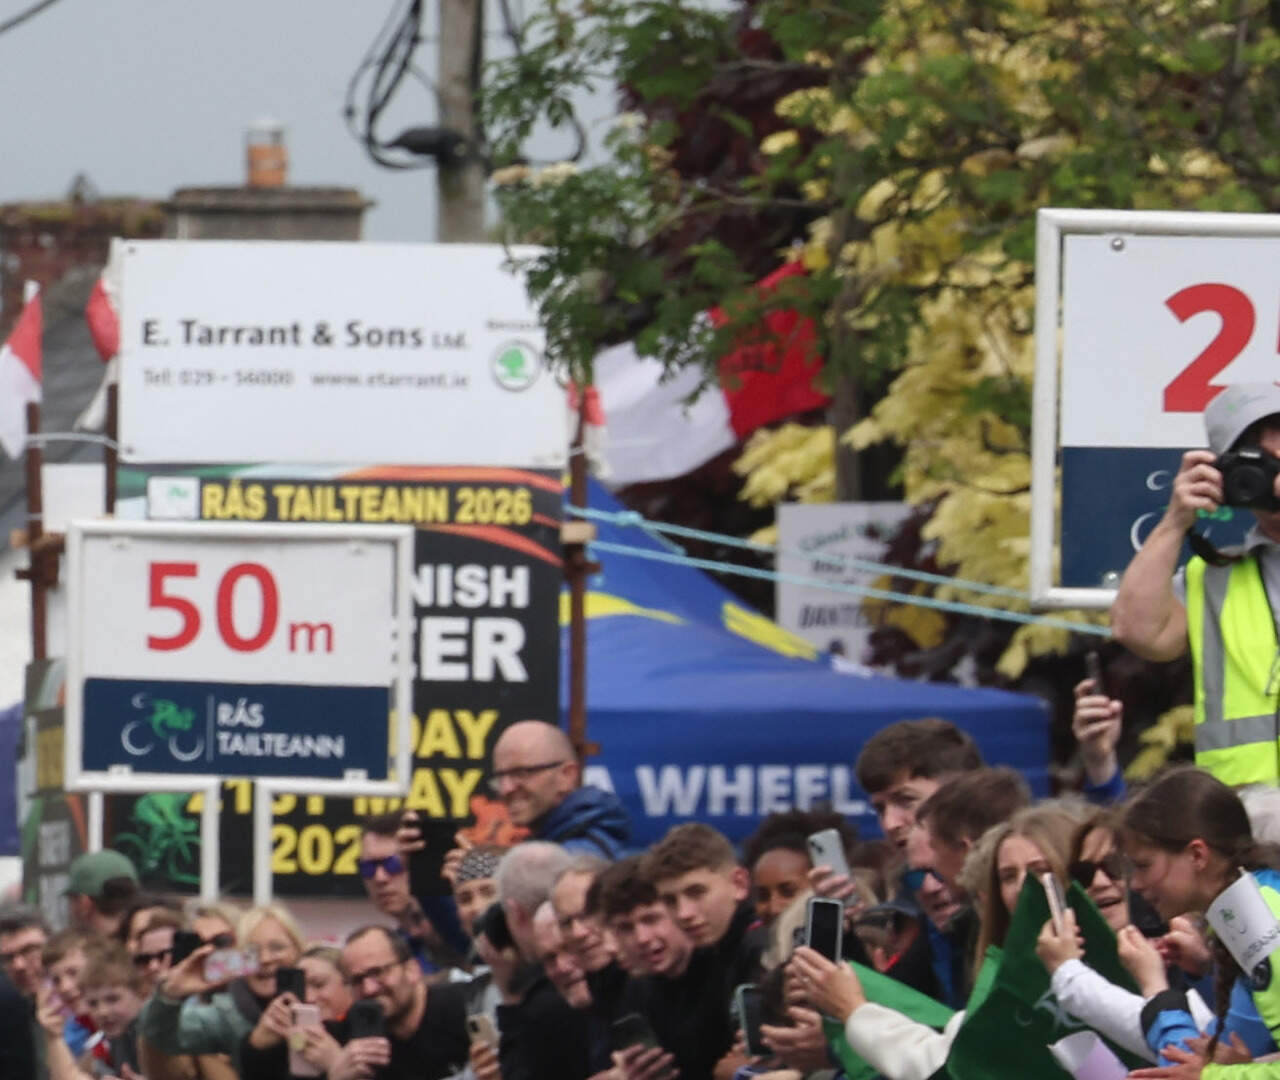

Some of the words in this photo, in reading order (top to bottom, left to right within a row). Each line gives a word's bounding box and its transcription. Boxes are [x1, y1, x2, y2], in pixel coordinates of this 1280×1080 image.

[141, 320, 169, 347] E.
[179, 320, 301, 347] Tarrant
[312, 321, 334, 347] &
[346, 319, 424, 348] Sons
[1162, 283, 1280, 413] 2
[202, 479, 267, 520] RÁS
[272, 485, 449, 523] TAILTEANN
[455, 487, 533, 525] 2026
[410, 563, 531, 608] NISH
[217, 698, 264, 727] RÁS
[216, 730, 345, 759] TAILTEANN
[635, 764, 877, 818] WHEEL
[270, 824, 365, 875] 202
